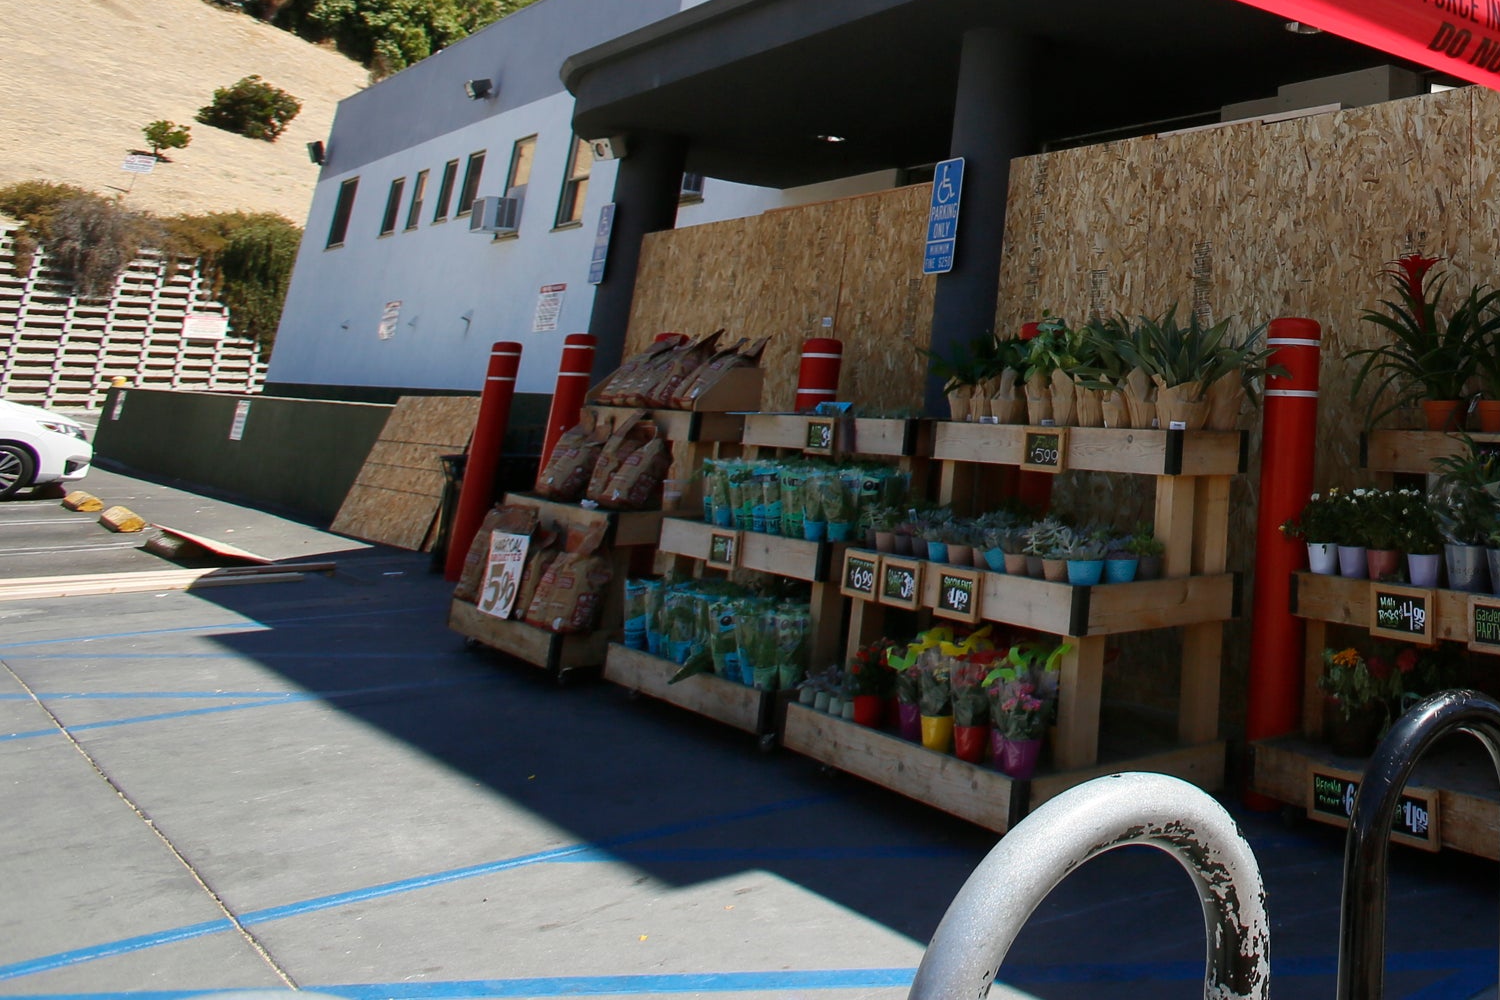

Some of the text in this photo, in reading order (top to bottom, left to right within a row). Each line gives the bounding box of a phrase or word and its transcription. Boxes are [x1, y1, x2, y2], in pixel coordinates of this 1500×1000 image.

[1427, 20, 1469, 58] DO
[930, 202, 958, 222] PARKING
[933, 222, 951, 239] ONLY
